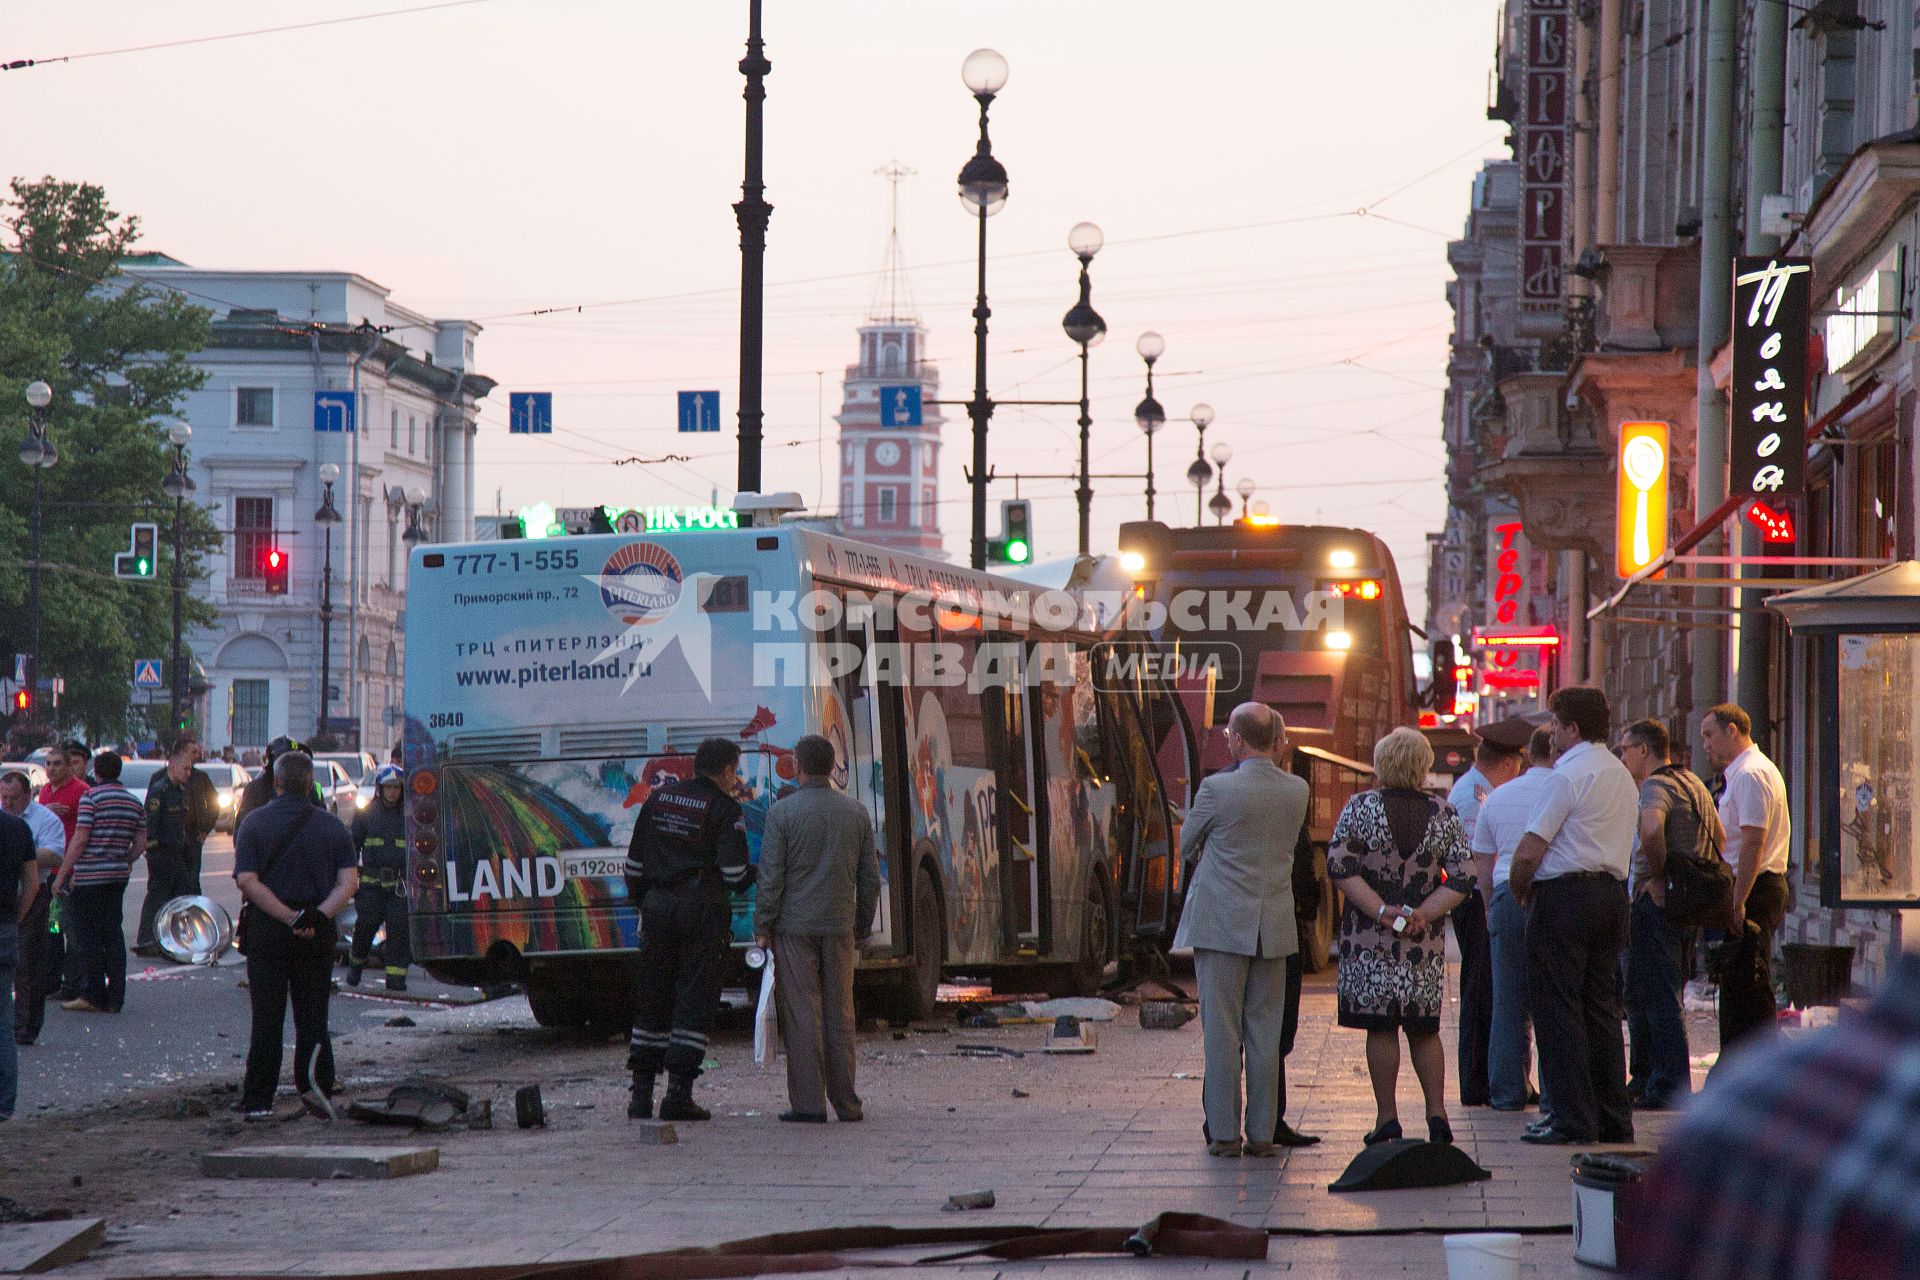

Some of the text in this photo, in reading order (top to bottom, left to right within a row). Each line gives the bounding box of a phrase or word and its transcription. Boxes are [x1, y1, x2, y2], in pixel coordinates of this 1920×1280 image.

[453, 549, 579, 575] 777-1-555
[454, 588, 533, 606] Приморский
[563, 586, 579, 599] 72
[608, 585, 676, 609] PITERLAND
[456, 641, 495, 657] ТРЦ
[456, 657, 652, 689] www.piterland.ru
[429, 711, 465, 728] 3640
[446, 856, 565, 902] LAND
